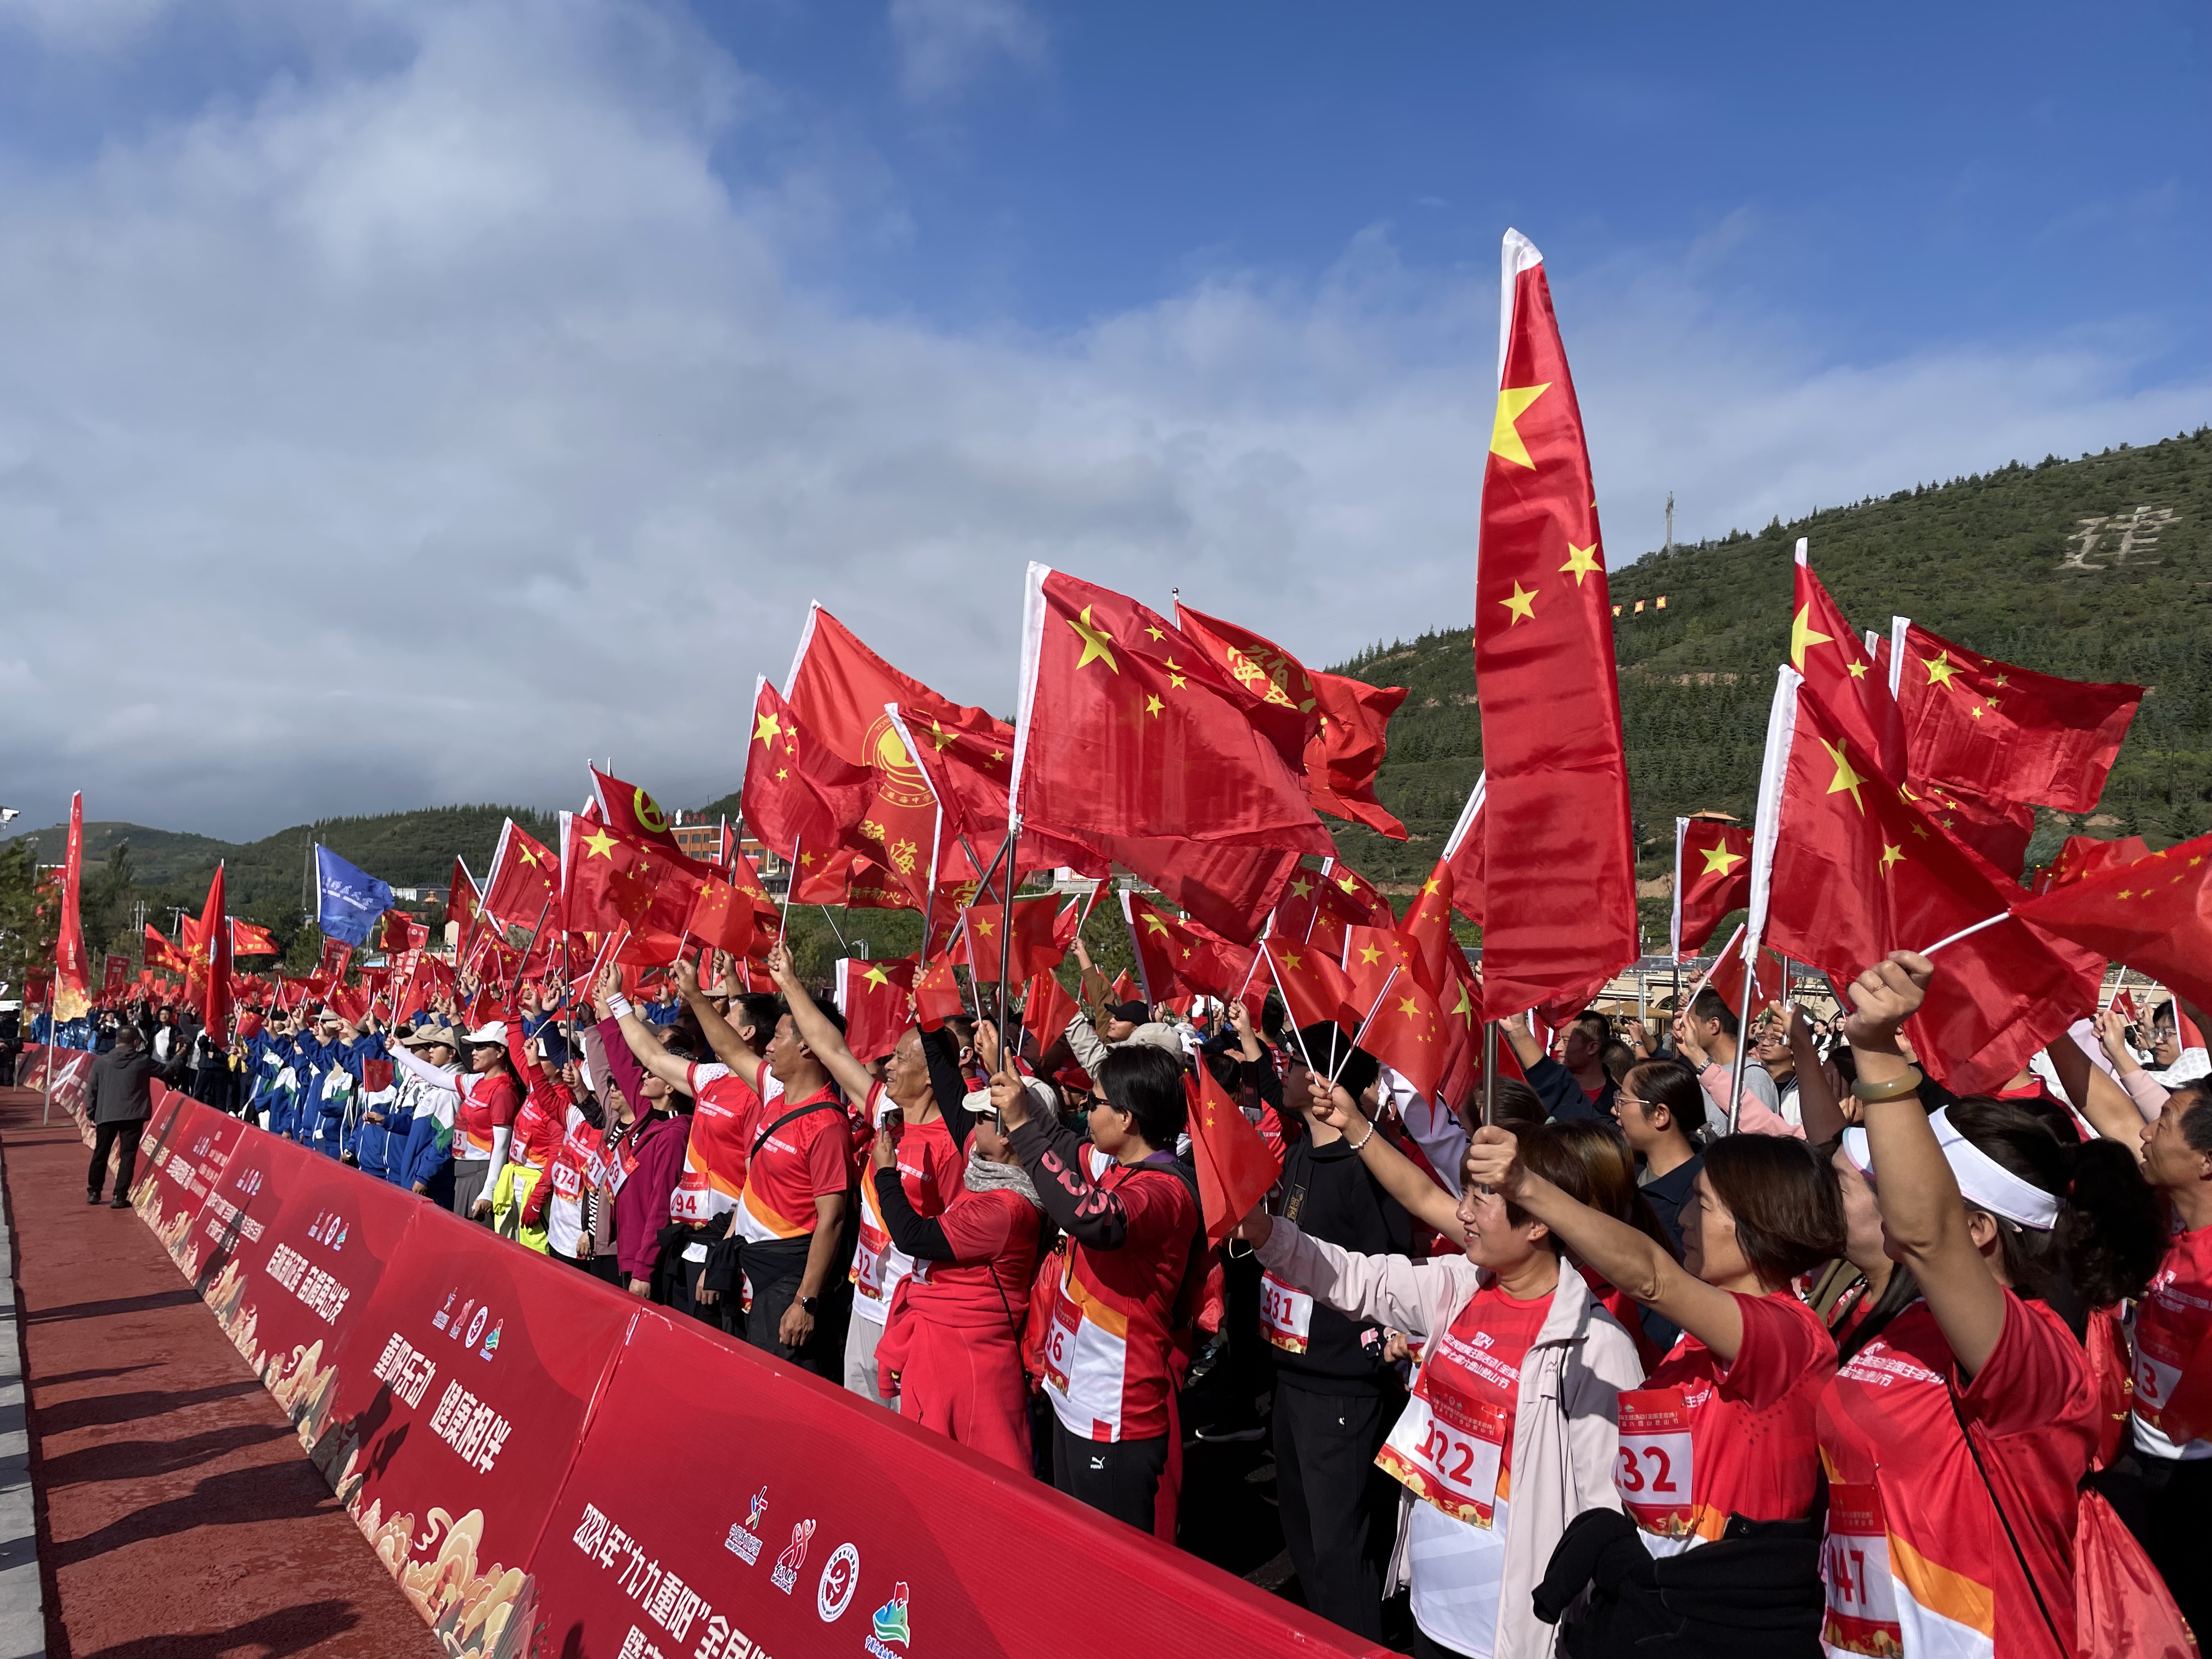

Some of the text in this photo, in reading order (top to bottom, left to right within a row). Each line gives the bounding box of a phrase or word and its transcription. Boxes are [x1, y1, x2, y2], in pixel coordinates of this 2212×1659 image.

[554, 1167, 575, 1189] 474
[588, 1156, 601, 1178] 87
[609, 1160, 620, 1184] 69
[1262, 1287, 1294, 1327] 531
[373, 1332, 512, 1474] 重阳乐动 健康相伴
[1414, 1419, 1476, 1487] 122
[1615, 1446, 1677, 1492] 32
